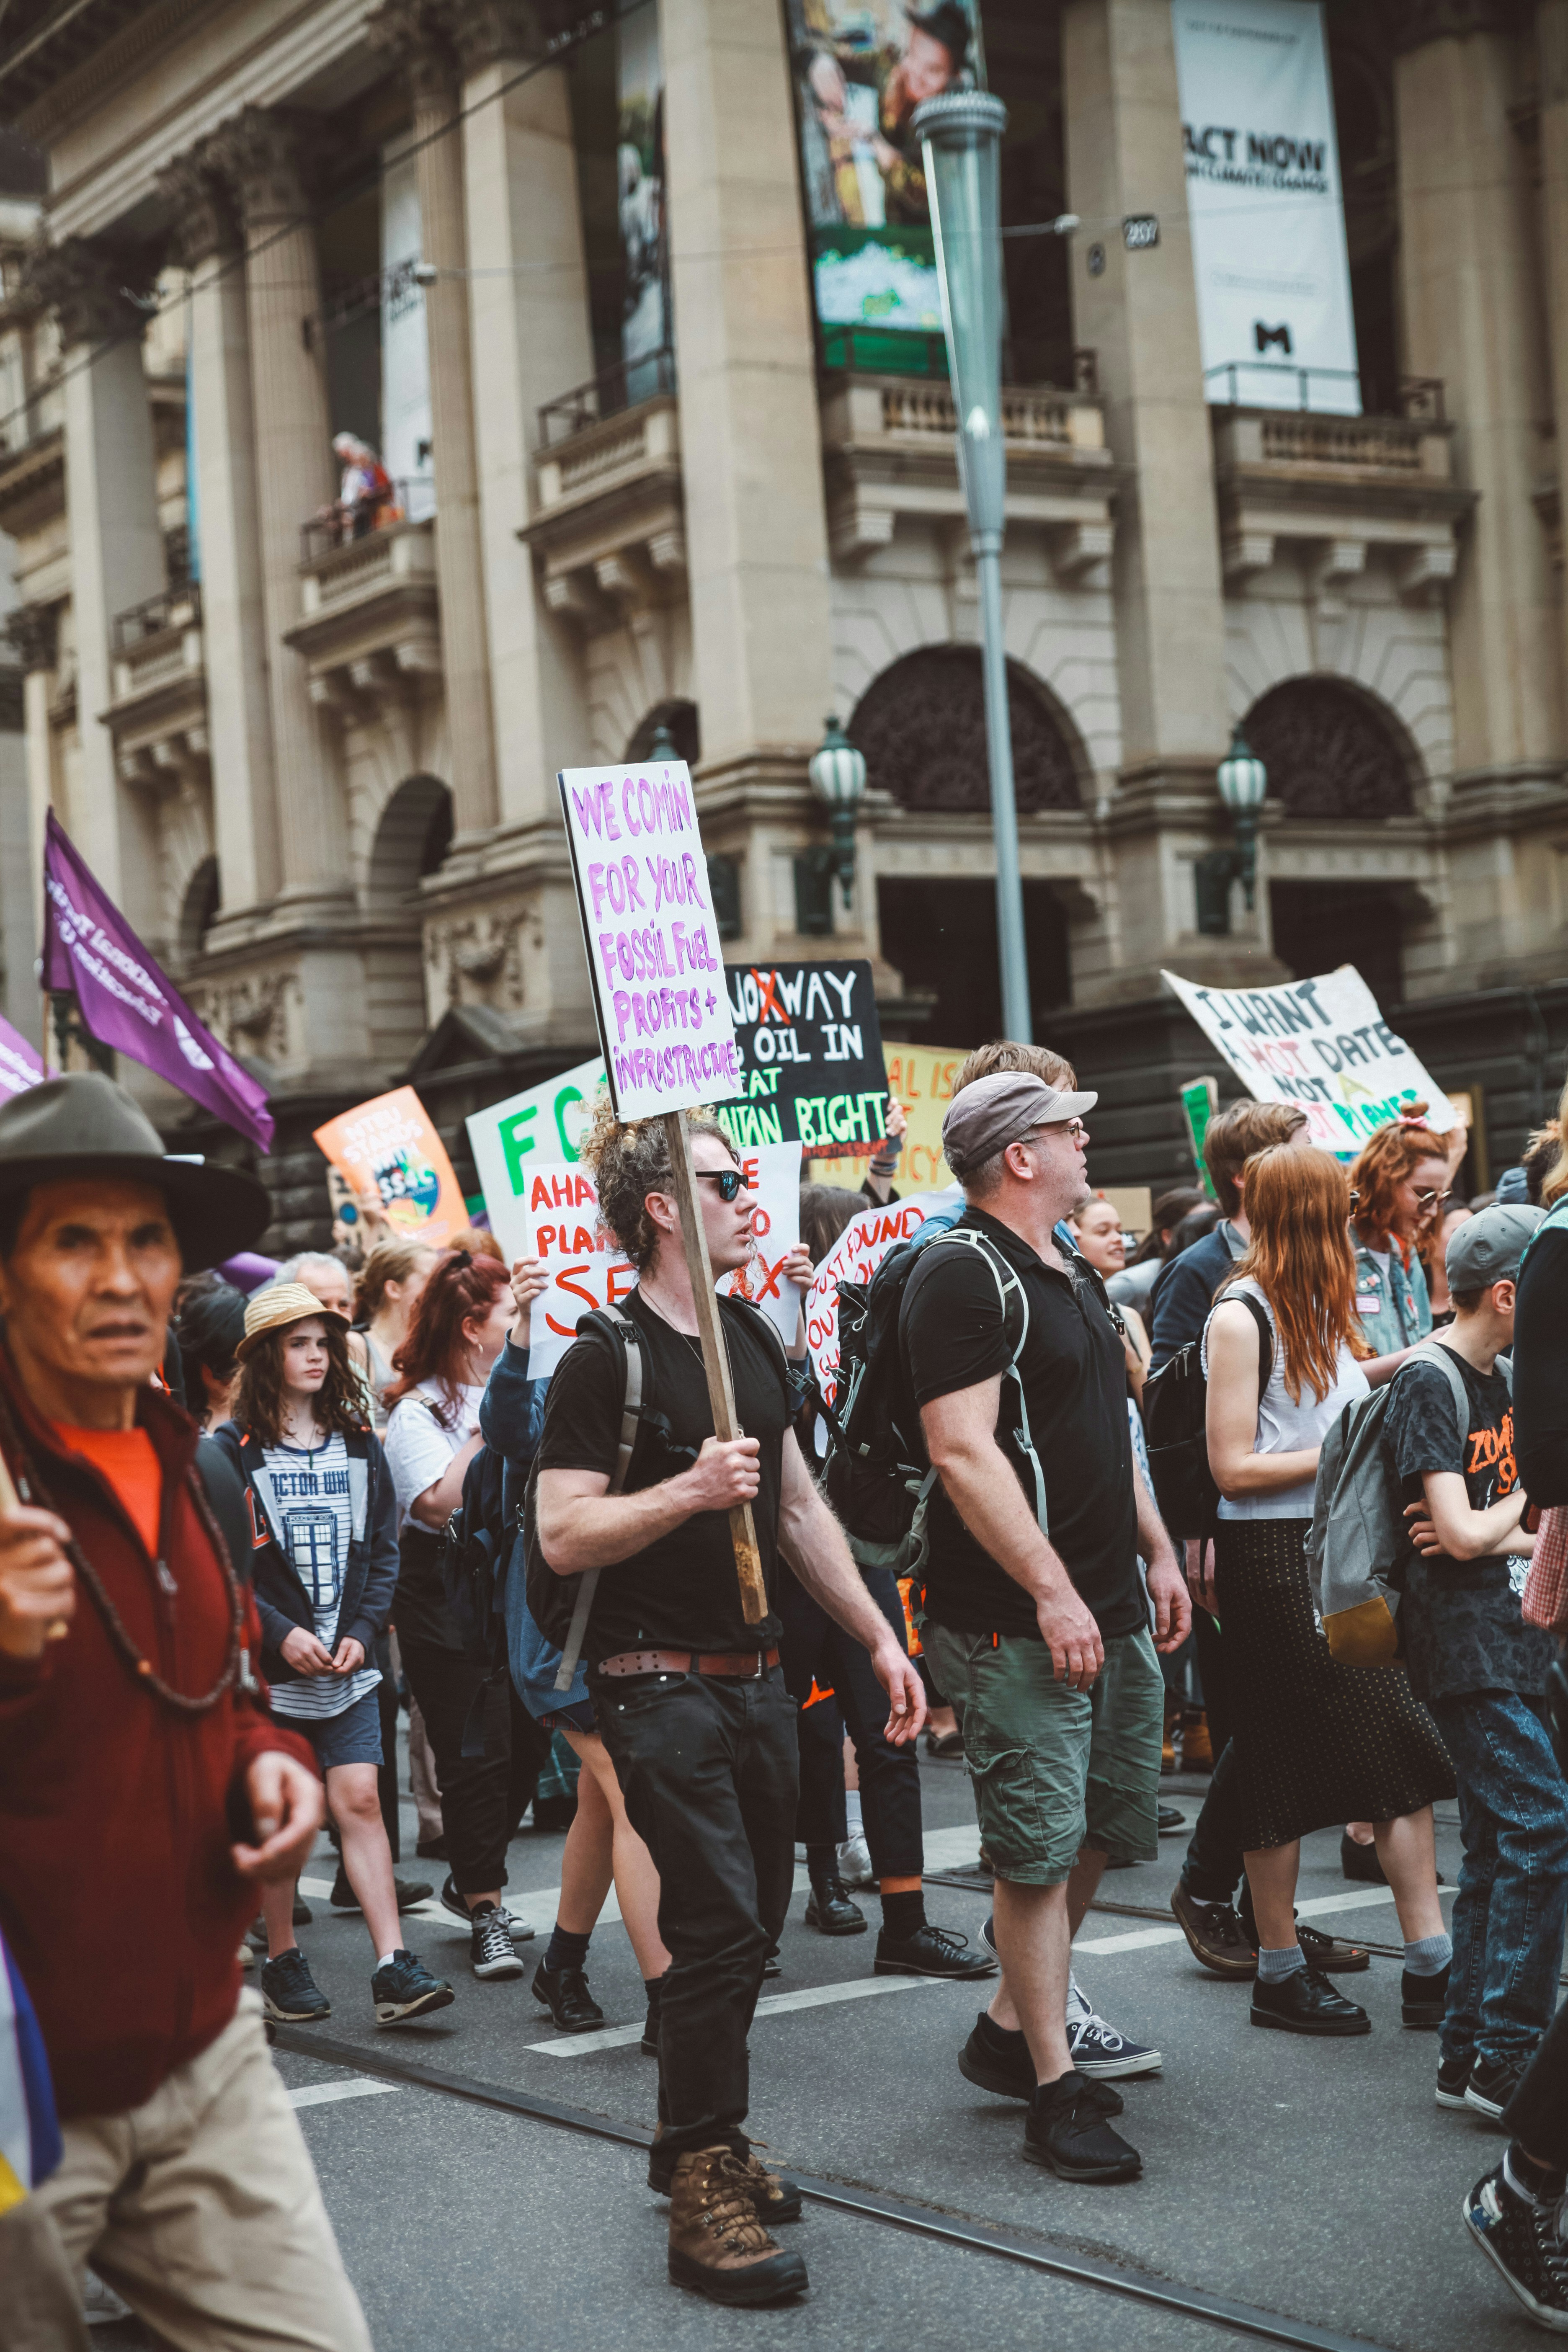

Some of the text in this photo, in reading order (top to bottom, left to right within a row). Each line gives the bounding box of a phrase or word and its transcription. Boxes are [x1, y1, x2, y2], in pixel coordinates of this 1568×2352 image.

[1248, 133, 1326, 171] NOW
[572, 781, 622, 841] WE
[587, 852, 707, 924] FOR YOUR
[1195, 980, 1332, 1037] I WANT
[754, 1026, 811, 1063] OIL
[820, 1024, 864, 1061] IN
[1218, 1022, 1405, 1077] A HOT DATE
[1272, 1072, 1374, 1102] NOT A
[343, 1119, 423, 1164] STANDS
[794, 1092, 888, 1148] BIGHT
[846, 1206, 926, 1264] FOUND
[323, 1469, 351, 1494] WH
